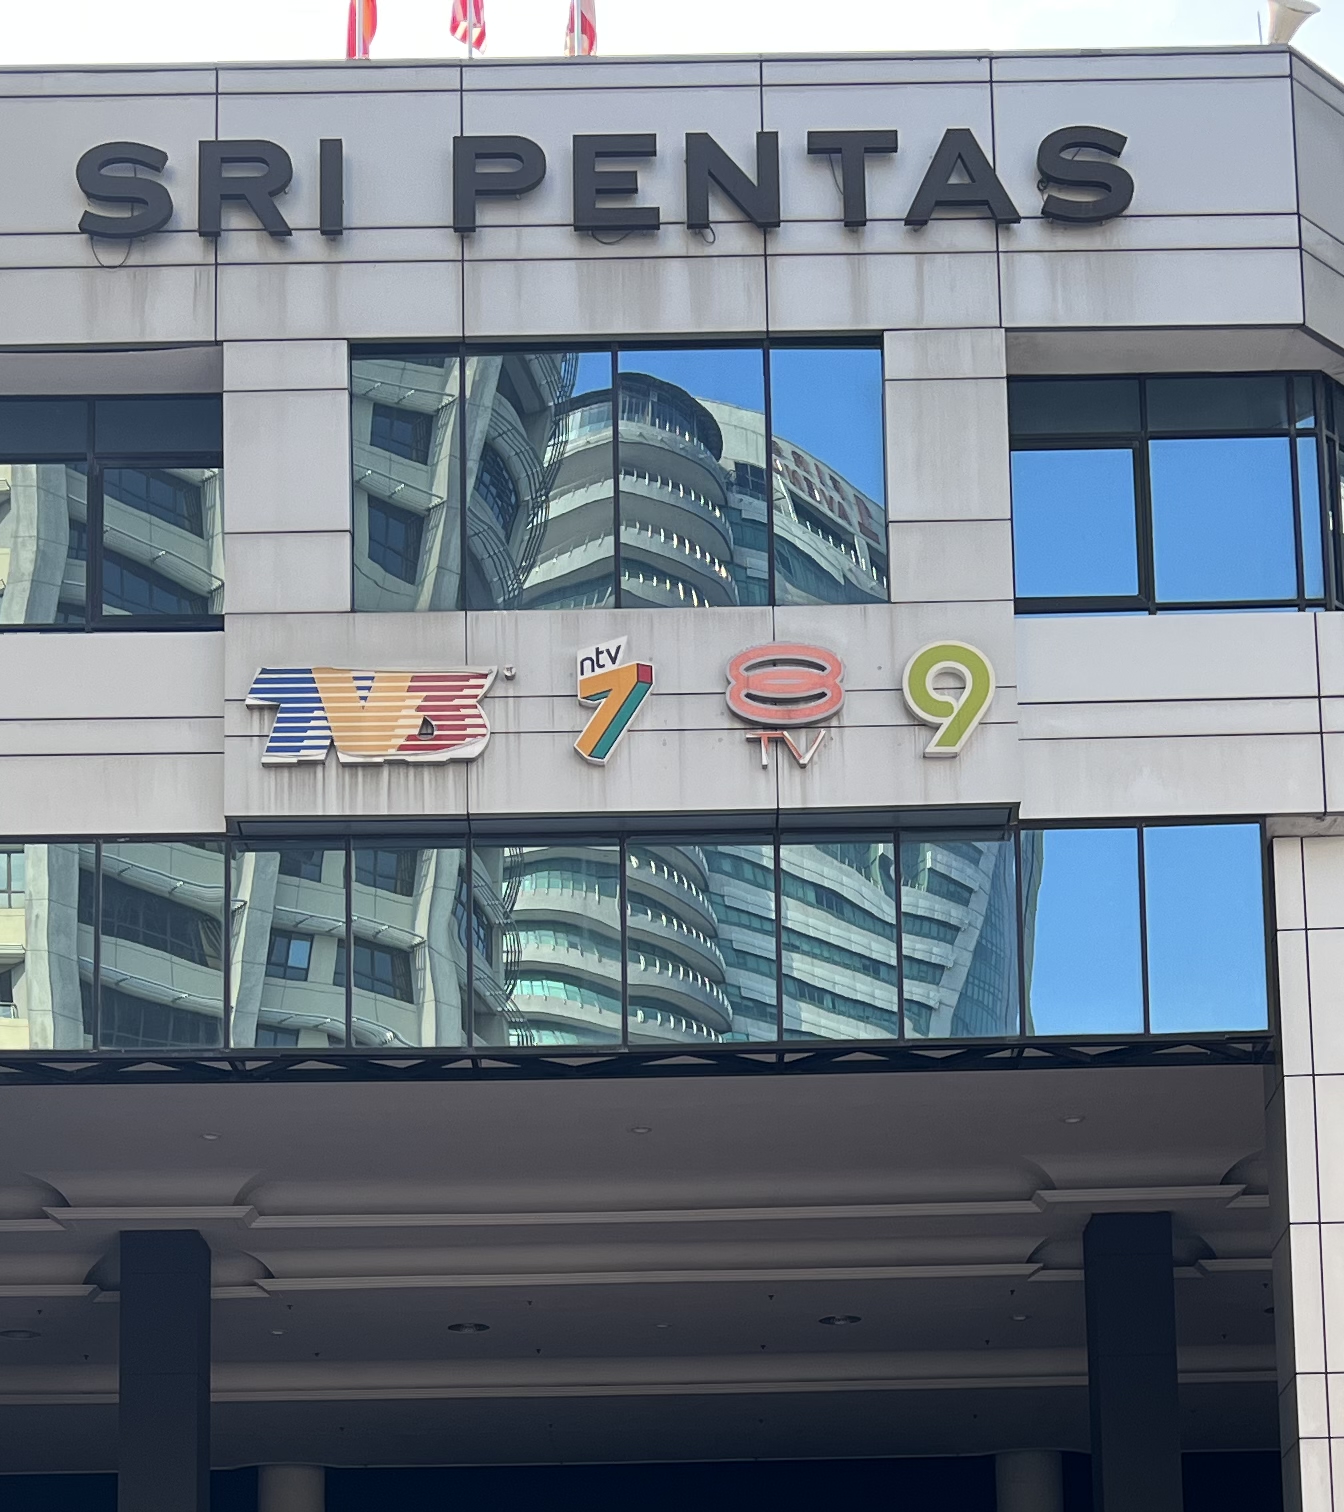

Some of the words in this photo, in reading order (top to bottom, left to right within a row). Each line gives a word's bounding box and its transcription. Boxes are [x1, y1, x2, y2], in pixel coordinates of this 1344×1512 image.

[76, 138, 344, 237] SRI
[452, 125, 1136, 233] PENTAS
[579, 643, 622, 677] ntv
[902, 639, 996, 759] 9
[745, 729, 827, 770] TV
